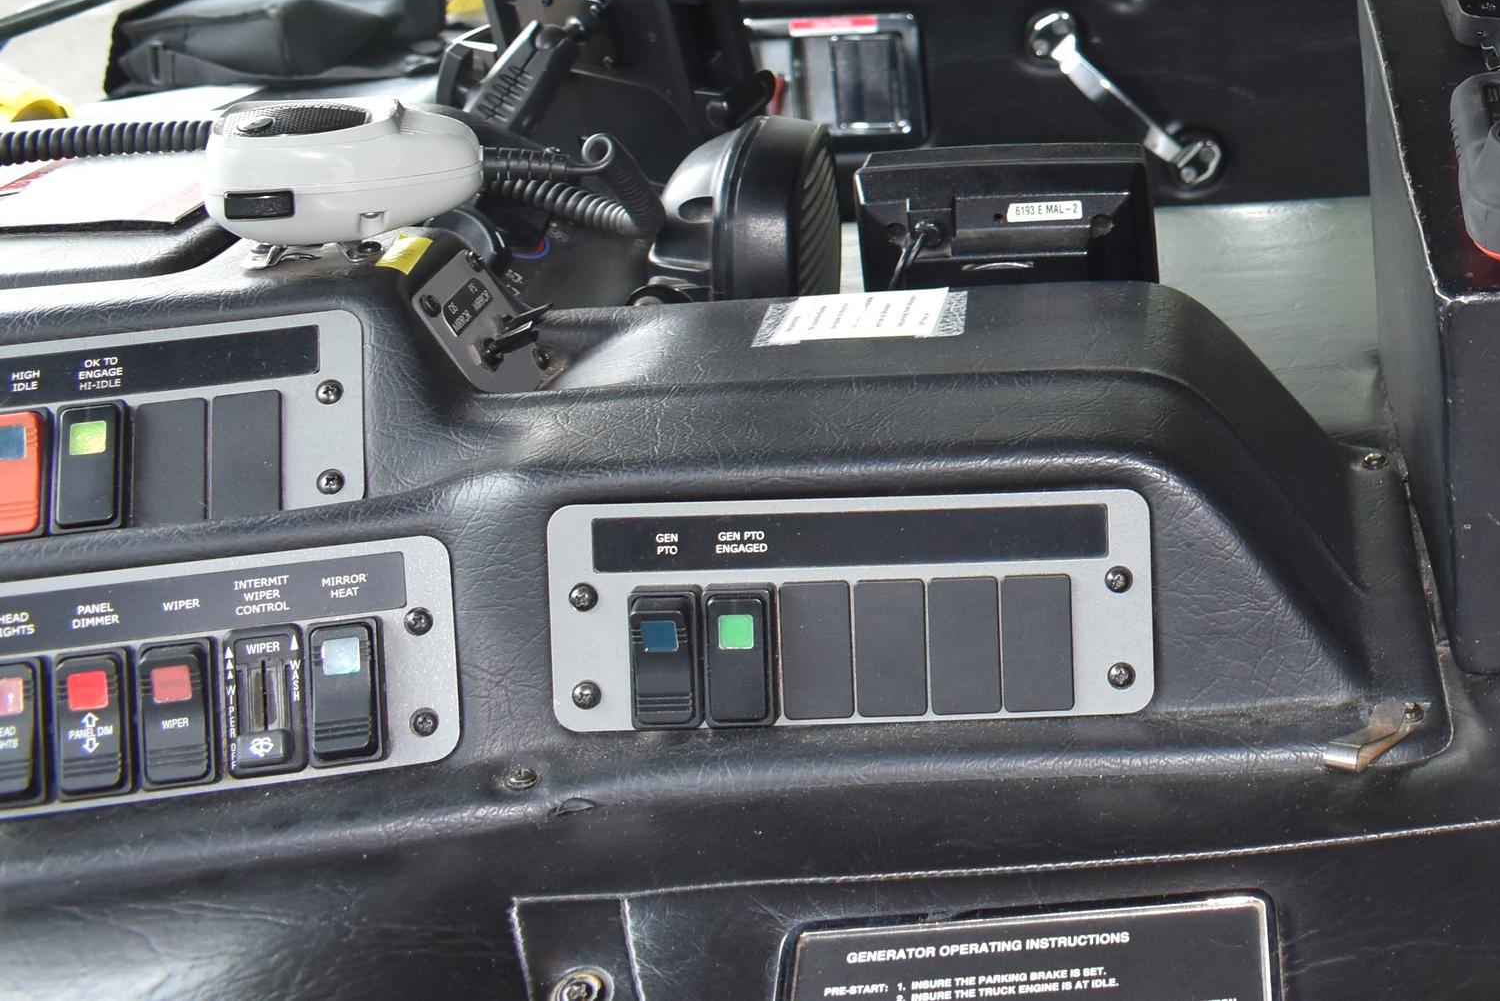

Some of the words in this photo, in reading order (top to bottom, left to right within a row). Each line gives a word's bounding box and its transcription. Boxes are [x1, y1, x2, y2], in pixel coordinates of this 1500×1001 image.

[84, 358, 101, 367] OK
[104, 357, 118, 365] TO
[12, 370, 40, 380] HIGH
[78, 367, 123, 379] ENGAGE
[12, 382, 38, 391] IDLE
[79, 379, 121, 390] HI-IDLE
[655, 533, 679, 543] GEN
[718, 532, 741, 542] GEN
[743, 531, 765, 541] PTO
[656, 545, 679, 555] PTO
[715, 543, 768, 554] ENGAGED
[234, 575, 290, 590] INTERMIT
[321, 573, 367, 587] MIRROR
[243, 589, 281, 602] WIPER
[330, 587, 360, 598] HEAT
[77, 602, 114, 616] PANEL
[162, 598, 201, 612] WIPER
[235, 601, 290, 616] CONTROL
[72, 614, 120, 630] DIMMER
[0, 624, 35, 637] IGHTS
[246, 641, 281, 655] WIPER
[289, 659, 301, 701] WASH
[226, 684, 238, 738] WIPER
[161, 717, 190, 730] WIPER
[0, 726, 16, 737] EAD
[68, 728, 97, 741] PANEL
[97, 725, 114, 737] DIM
[846, 945, 936, 964] GENERATOR
[939, 939, 1022, 957] OPERATING
[1025, 931, 1131, 950] INSTRUCTIONS
[823, 983, 889, 998] PRE-START:
[897, 981, 906, 992] 1.
[911, 978, 952, 991] INSURE
[954, 976, 976, 987] THE
[978, 972, 1028, 985] PARKING
[1030, 969, 1068, 981] BRAKE
[1070, 968, 1081, 978] IS
[1083, 966, 1107, 977] SET.
[911, 990, 952, 1001] INSURE
[954, 988, 976, 999] THE
[979, 985, 1016, 997] TRUCK
[1018, 983, 1060, 995] ENGINE
[1062, 981, 1072, 991] IS
[1074, 980, 1090, 990] AT
[1091, 978, 1120, 988] IDLE.
